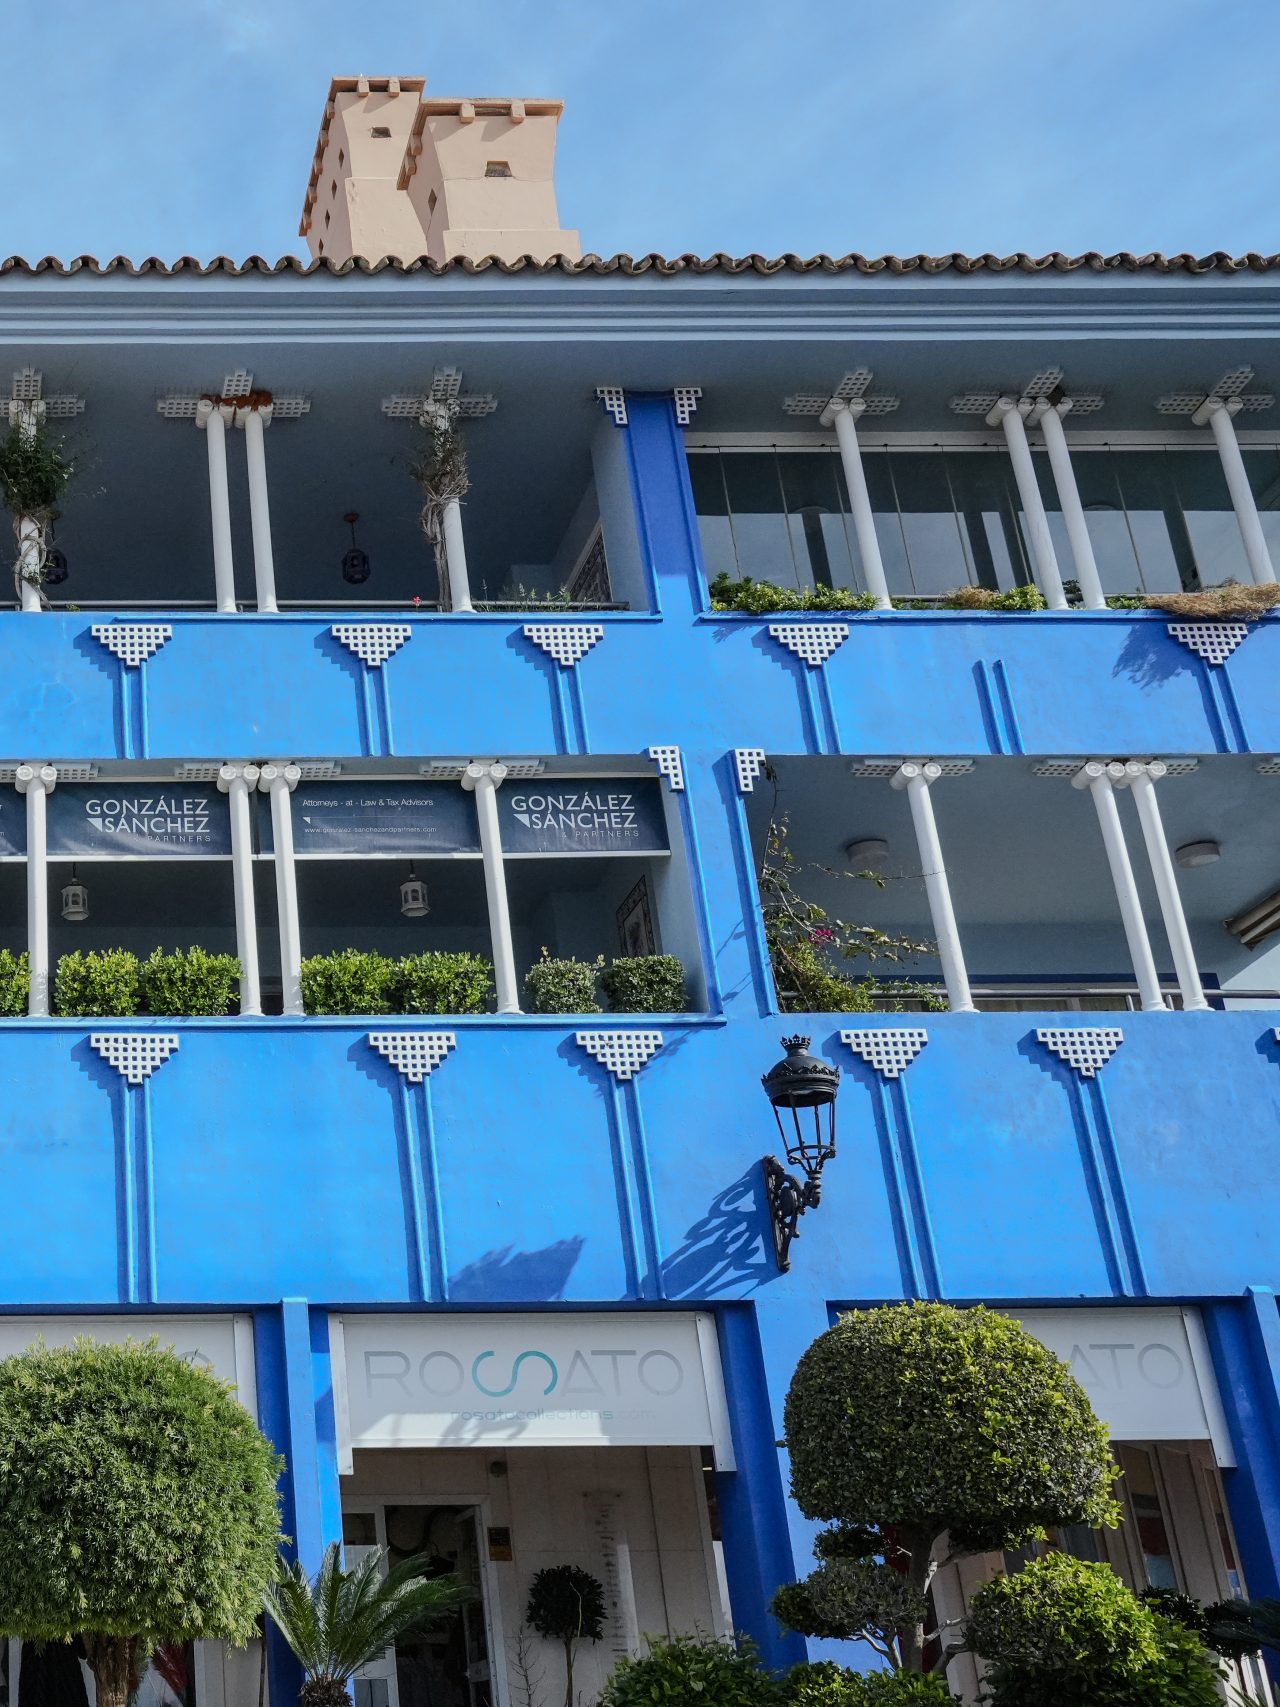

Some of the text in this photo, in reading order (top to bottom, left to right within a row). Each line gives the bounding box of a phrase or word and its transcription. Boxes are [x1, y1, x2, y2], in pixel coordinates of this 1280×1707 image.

[85, 795, 210, 815] GONZÁLEZ
[302, 799, 337, 807] Attorneys
[386, 798, 399, 806] Tax
[400, 798, 434, 806] Advisors
[511, 791, 635, 810] GONZÁLEZ
[105, 813, 210, 833] SÁNCHEZ
[531, 809, 638, 829] SÁNCHEZ
[575, 830, 640, 838] PARTNERS
[363, 1348, 684, 1398] ROSATO
